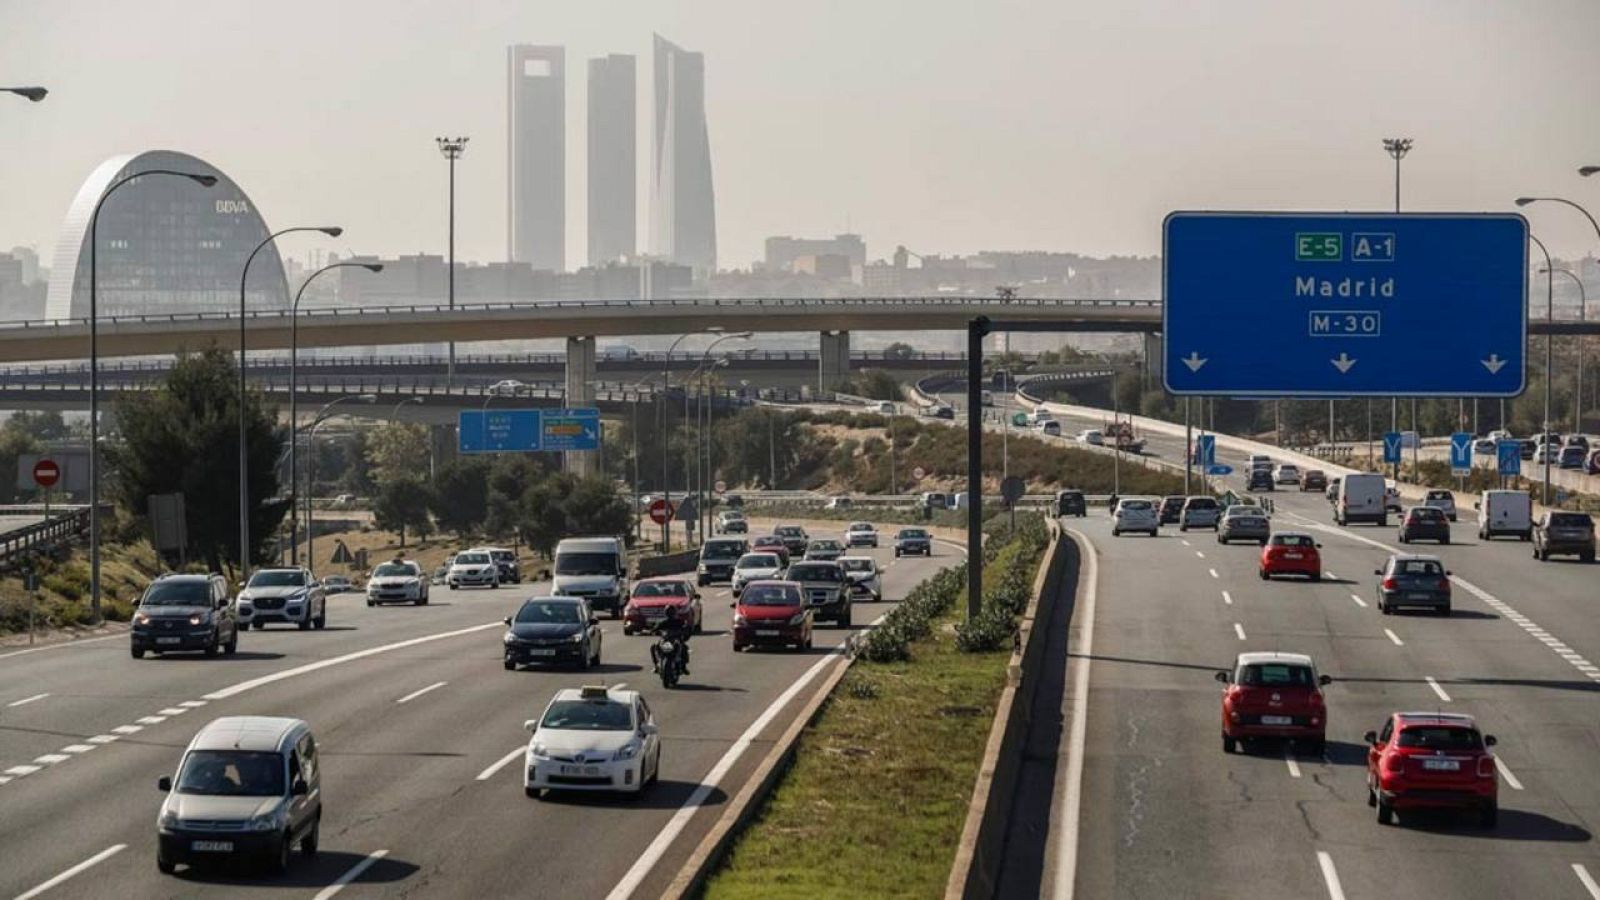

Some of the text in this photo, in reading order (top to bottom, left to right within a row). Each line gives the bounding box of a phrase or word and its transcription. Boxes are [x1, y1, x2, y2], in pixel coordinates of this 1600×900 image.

[215, 199, 249, 214] BBVA
[1299, 238, 1392, 256] E-5 A-1
[1296, 276, 1395, 297] Madrid
[1313, 315, 1376, 332] M-30
